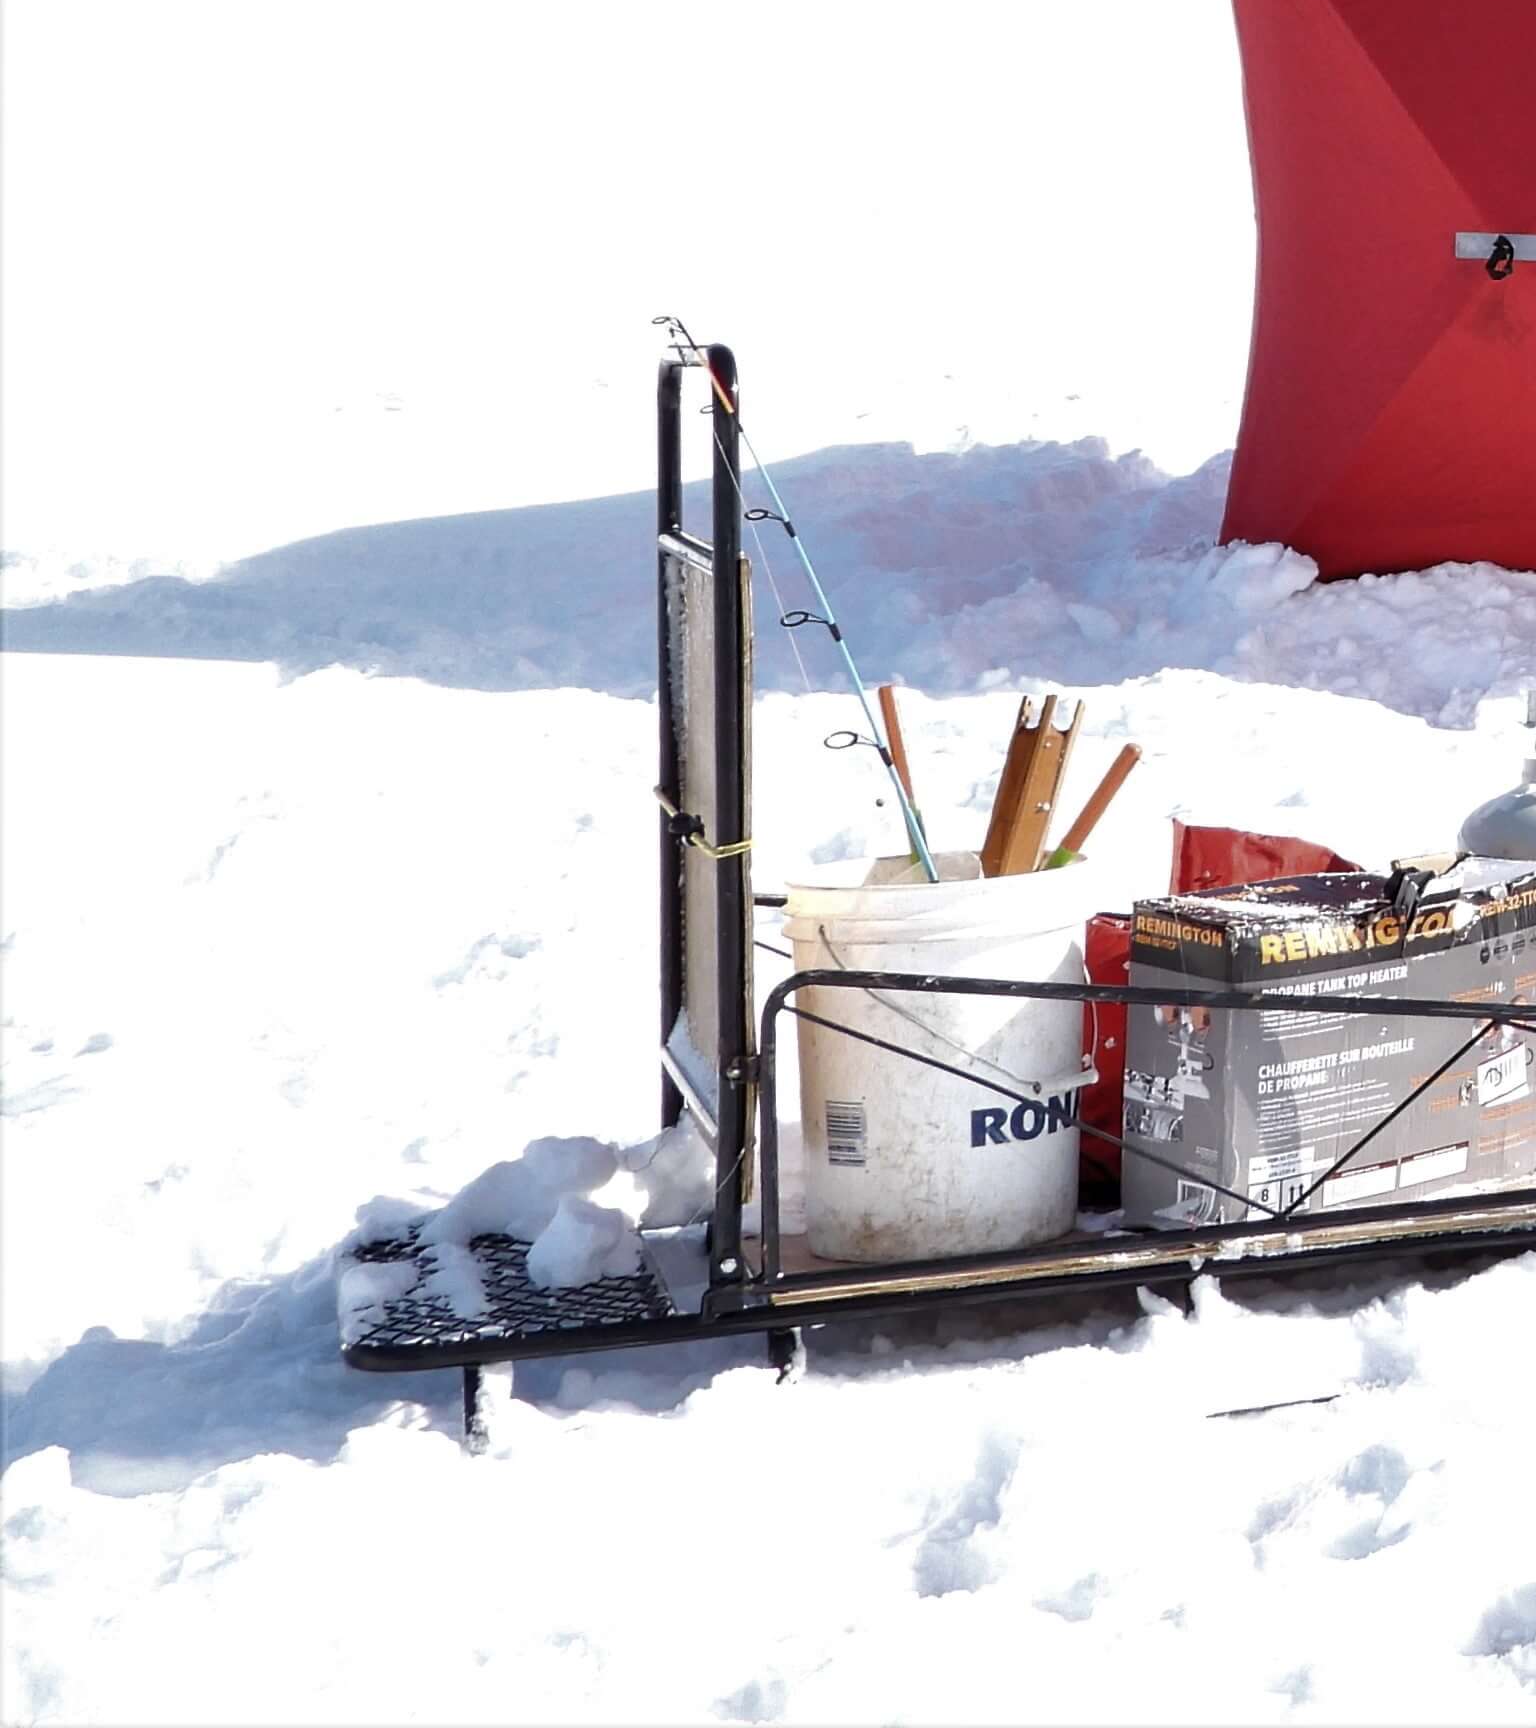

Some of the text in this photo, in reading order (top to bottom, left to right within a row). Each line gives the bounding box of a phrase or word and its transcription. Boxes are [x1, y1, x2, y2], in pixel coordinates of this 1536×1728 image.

[1136, 915, 1223, 948] REMINGTON
[1317, 976, 1347, 993] TANK
[1347, 973, 1368, 988] TOP
[1369, 966, 1409, 985] HEATER
[1258, 1037, 1415, 1078] CHAUFFERETTE SUR BOUTEILLE
[1258, 1070, 1328, 1094] DE PROPANE
[1261, 1189, 1269, 1203] 8
